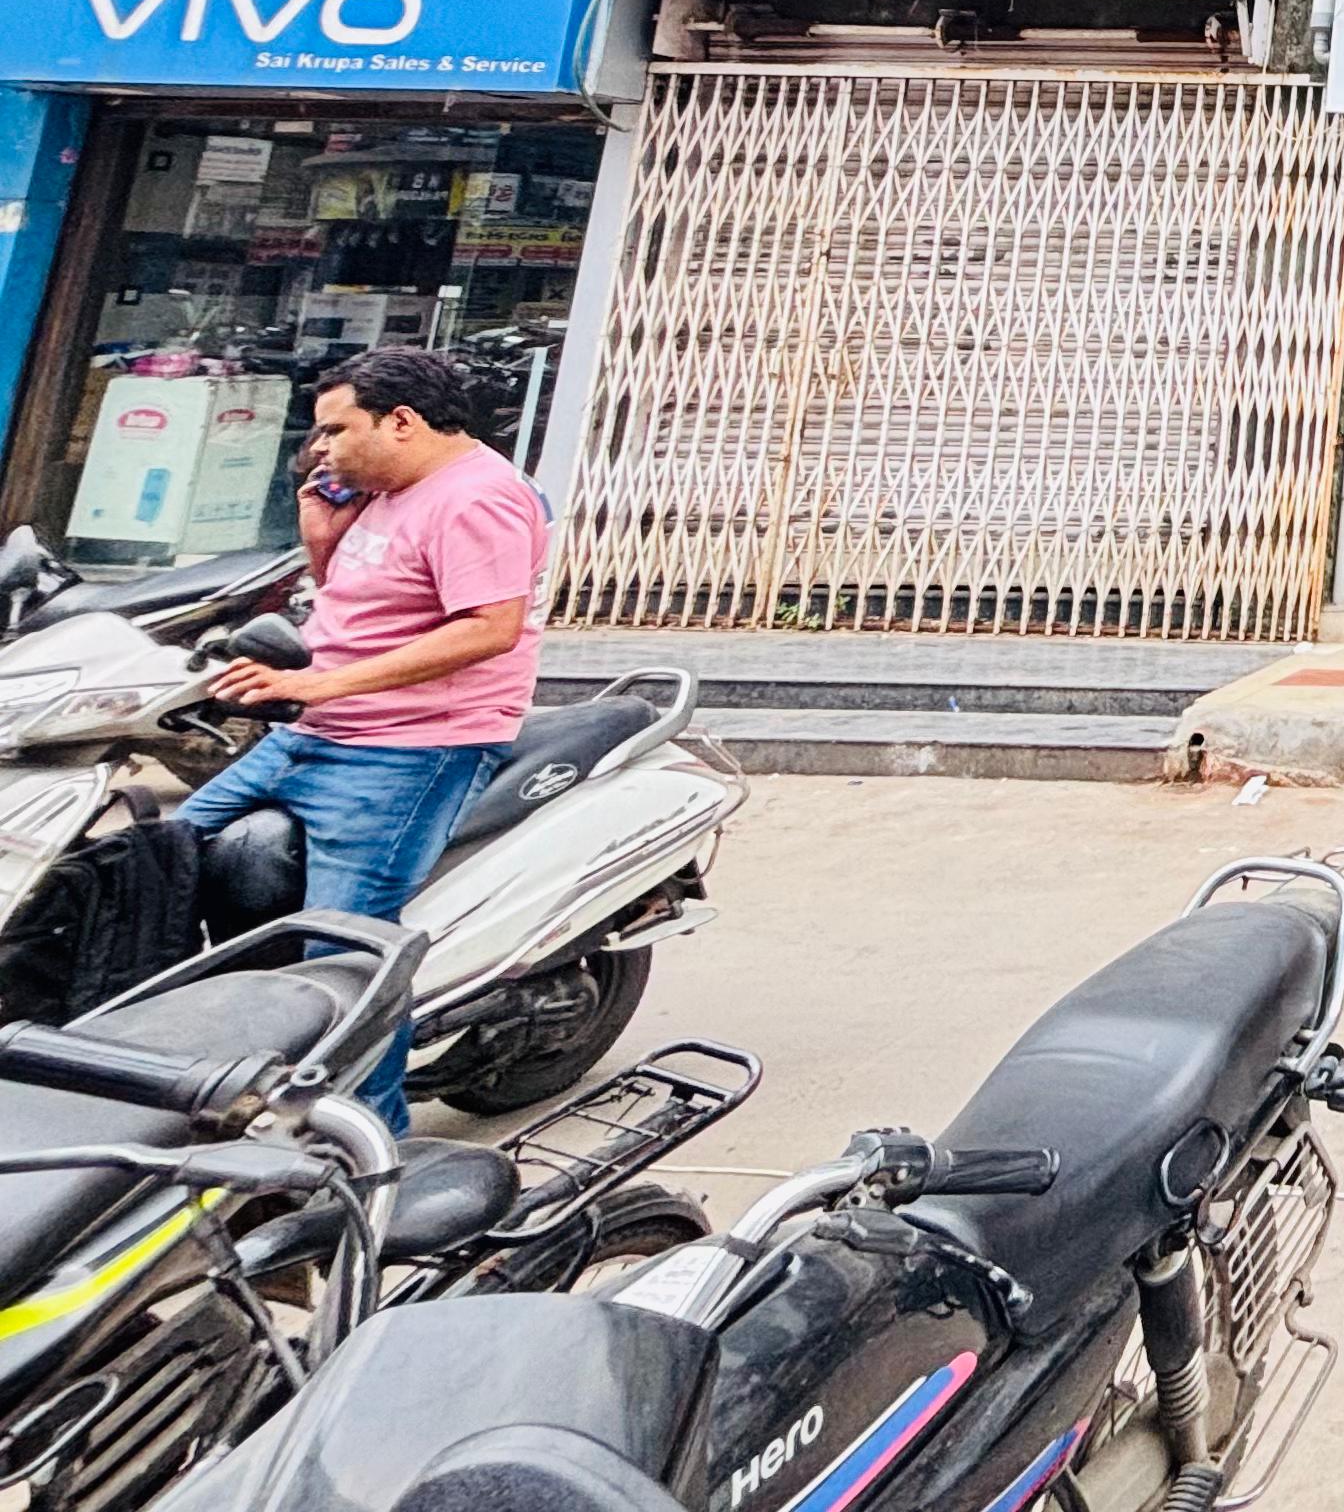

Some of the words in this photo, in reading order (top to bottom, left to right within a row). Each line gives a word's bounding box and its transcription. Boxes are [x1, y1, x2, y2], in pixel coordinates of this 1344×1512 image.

[255, 51, 291, 68] Sai
[296, 53, 364, 75] Krupa
[370, 54, 430, 72] Sales
[436, 56, 453, 73] &
[460, 55, 546, 74] Service
[730, 1404, 825, 1509] Hero
